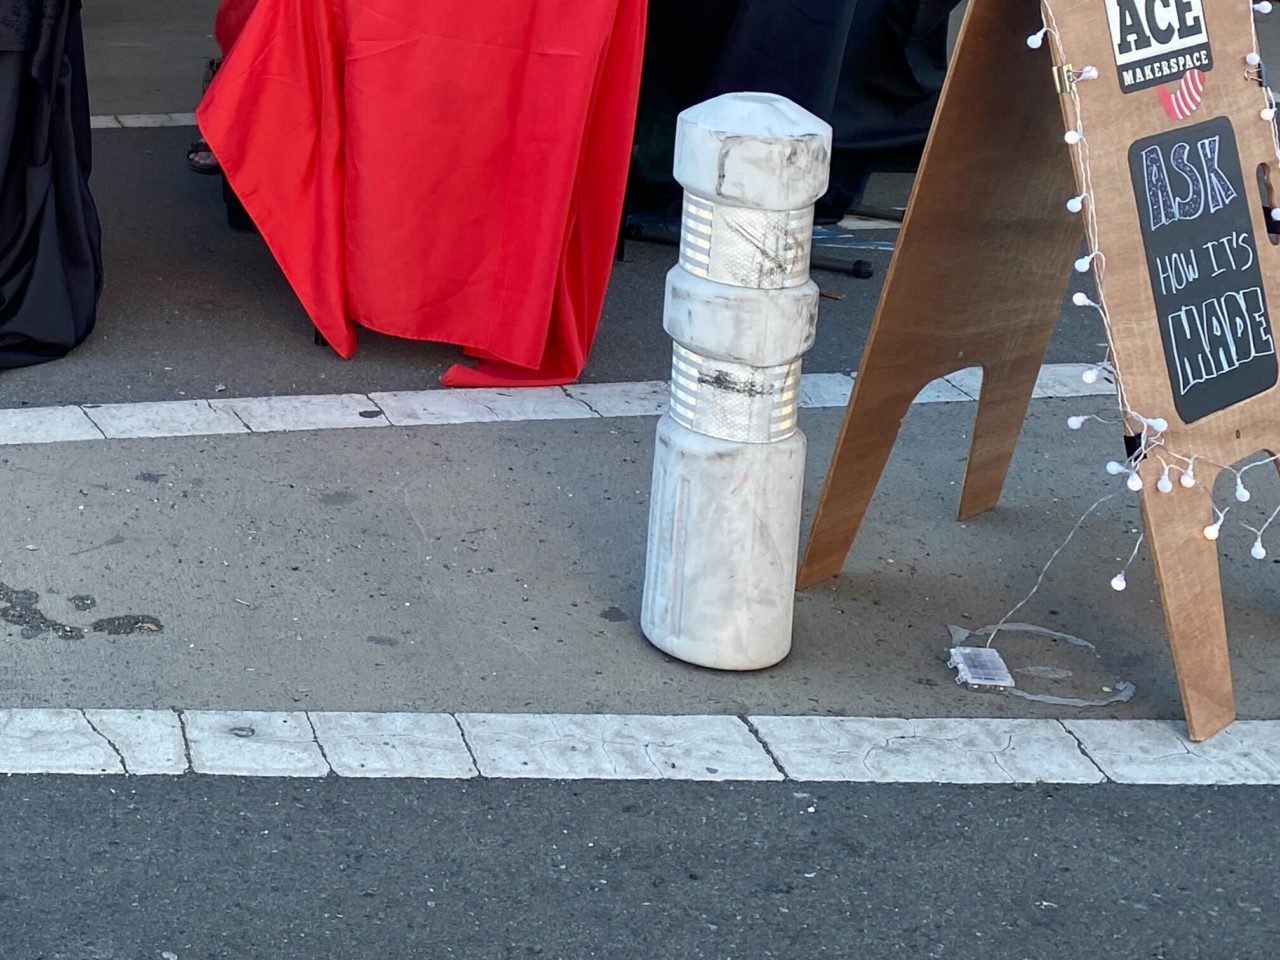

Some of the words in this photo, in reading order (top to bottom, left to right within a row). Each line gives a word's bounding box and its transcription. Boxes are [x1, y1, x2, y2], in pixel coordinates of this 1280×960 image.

[1122, 50, 1210, 87] MAKERSPACE
[1141, 135, 1237, 232] ASK
[1158, 252, 1201, 296] HOW
[1207, 232, 1254, 279] IT'S
[1168, 287, 1274, 395] MADE
